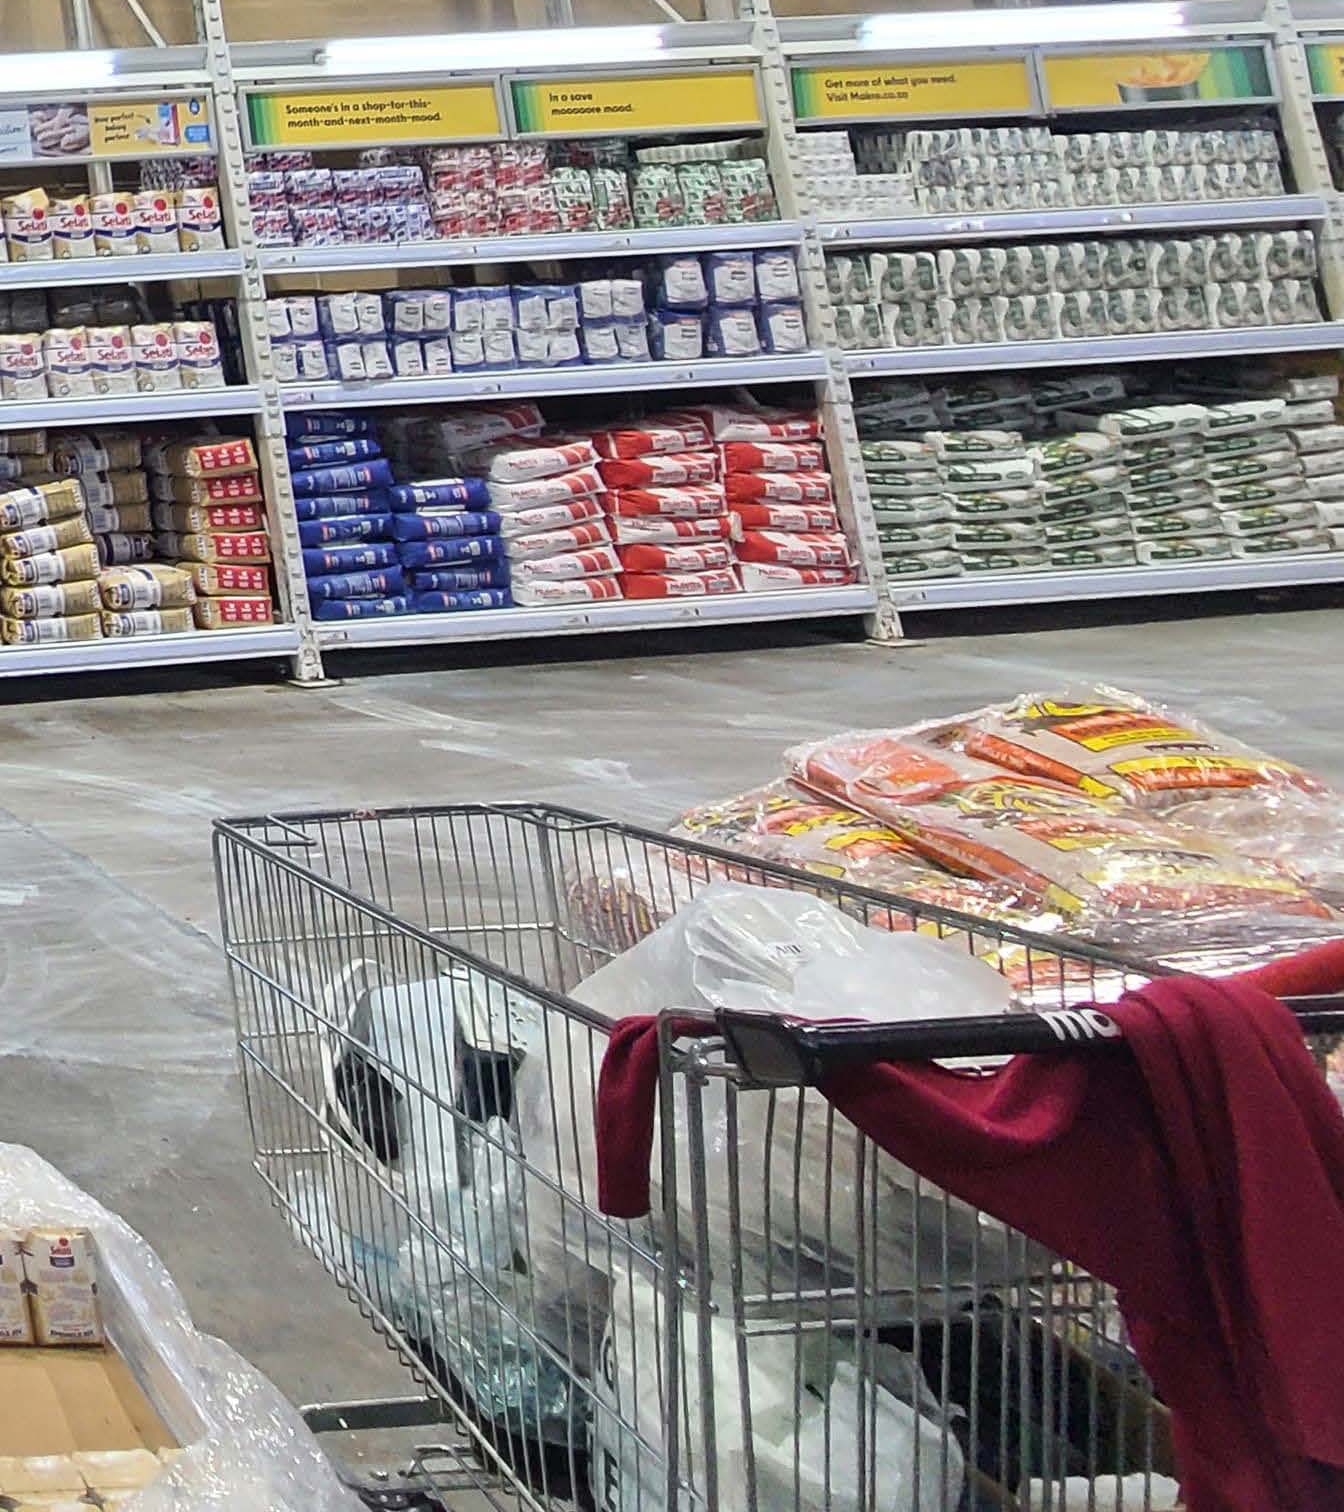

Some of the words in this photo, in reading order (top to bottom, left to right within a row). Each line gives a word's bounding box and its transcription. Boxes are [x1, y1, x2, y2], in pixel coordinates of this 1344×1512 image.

[824, 79, 843, 88] Get
[872, 77, 881, 86] of
[286, 102, 338, 114] Someone's
[353, 103, 359, 111] a
[362, 98, 431, 112] shop-for-this-
